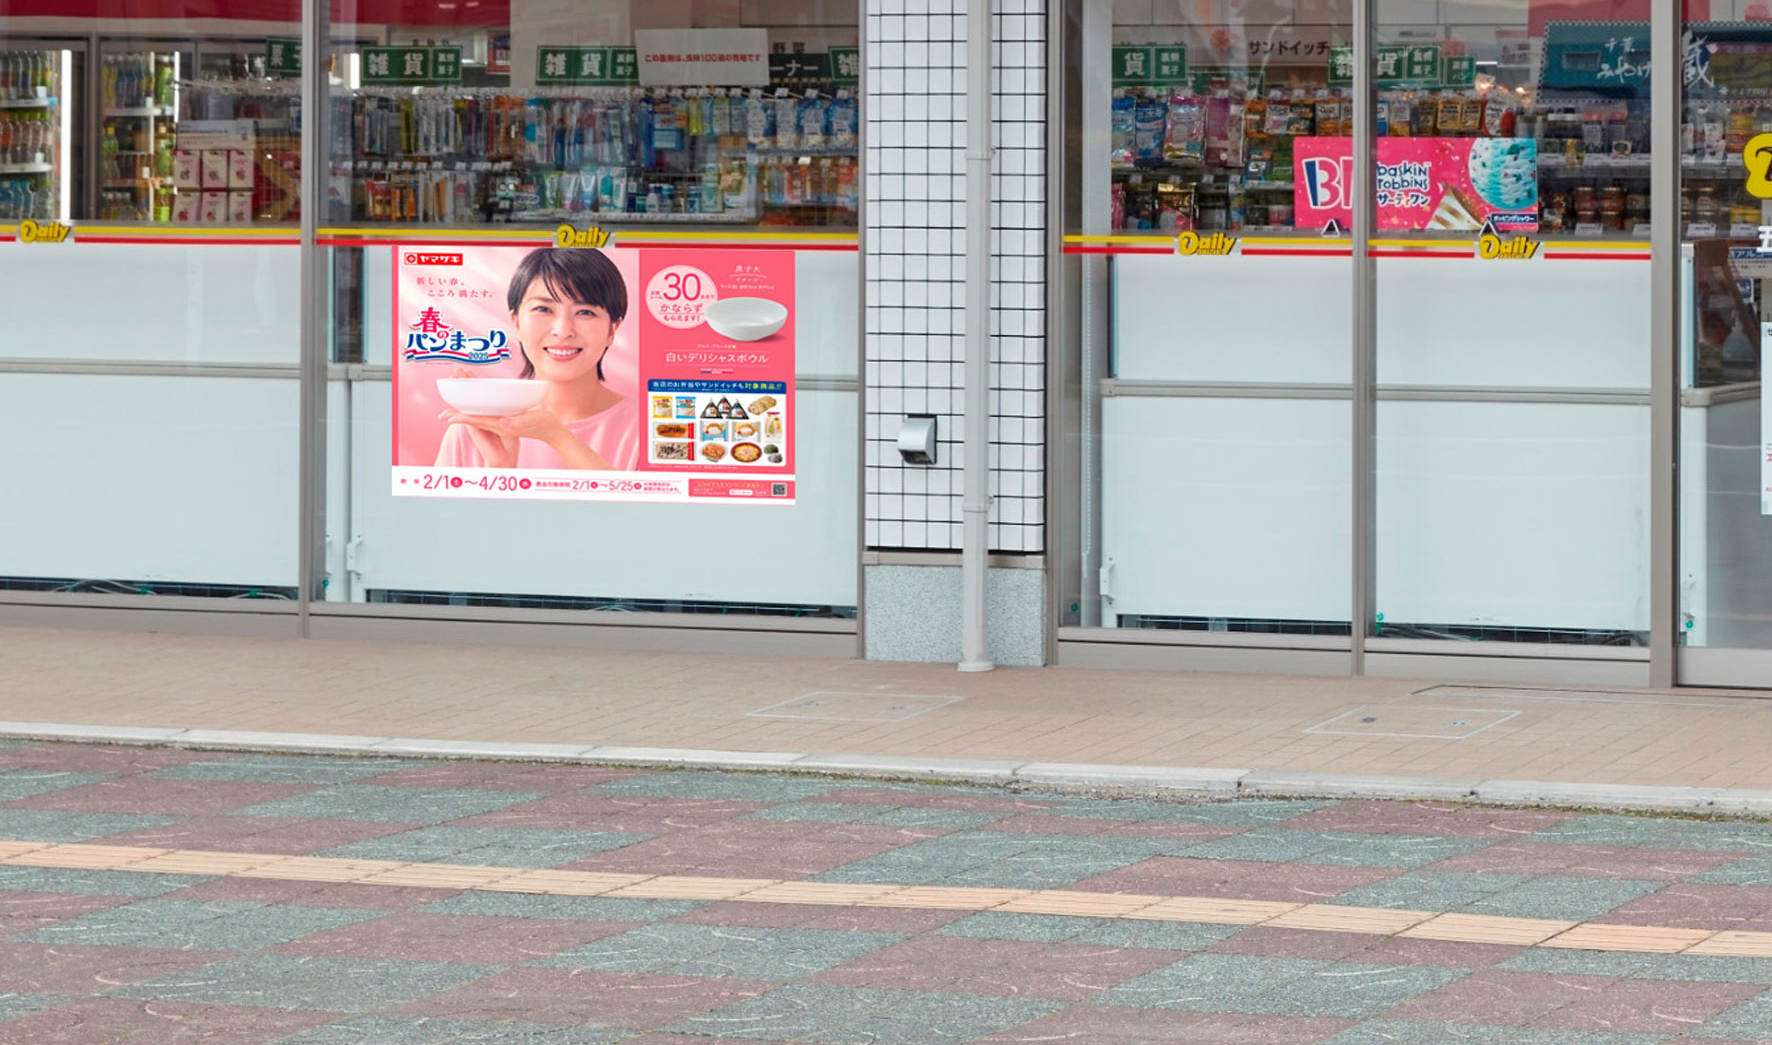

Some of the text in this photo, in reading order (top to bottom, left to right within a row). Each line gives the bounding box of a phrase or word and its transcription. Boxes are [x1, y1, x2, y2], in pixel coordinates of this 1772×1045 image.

[1250, 40, 1330, 55] サンドイッチ
[368, 53, 423, 76] 雑貨
[545, 53, 602, 76] 雑貨
[20, 219, 71, 243] Daily
[557, 224, 610, 248] Daily
[1179, 230, 1237, 255] Daily
[1479, 234, 1540, 259] Daily
[663, 272, 701, 301] 30
[407, 329, 507, 353] パンまつり
